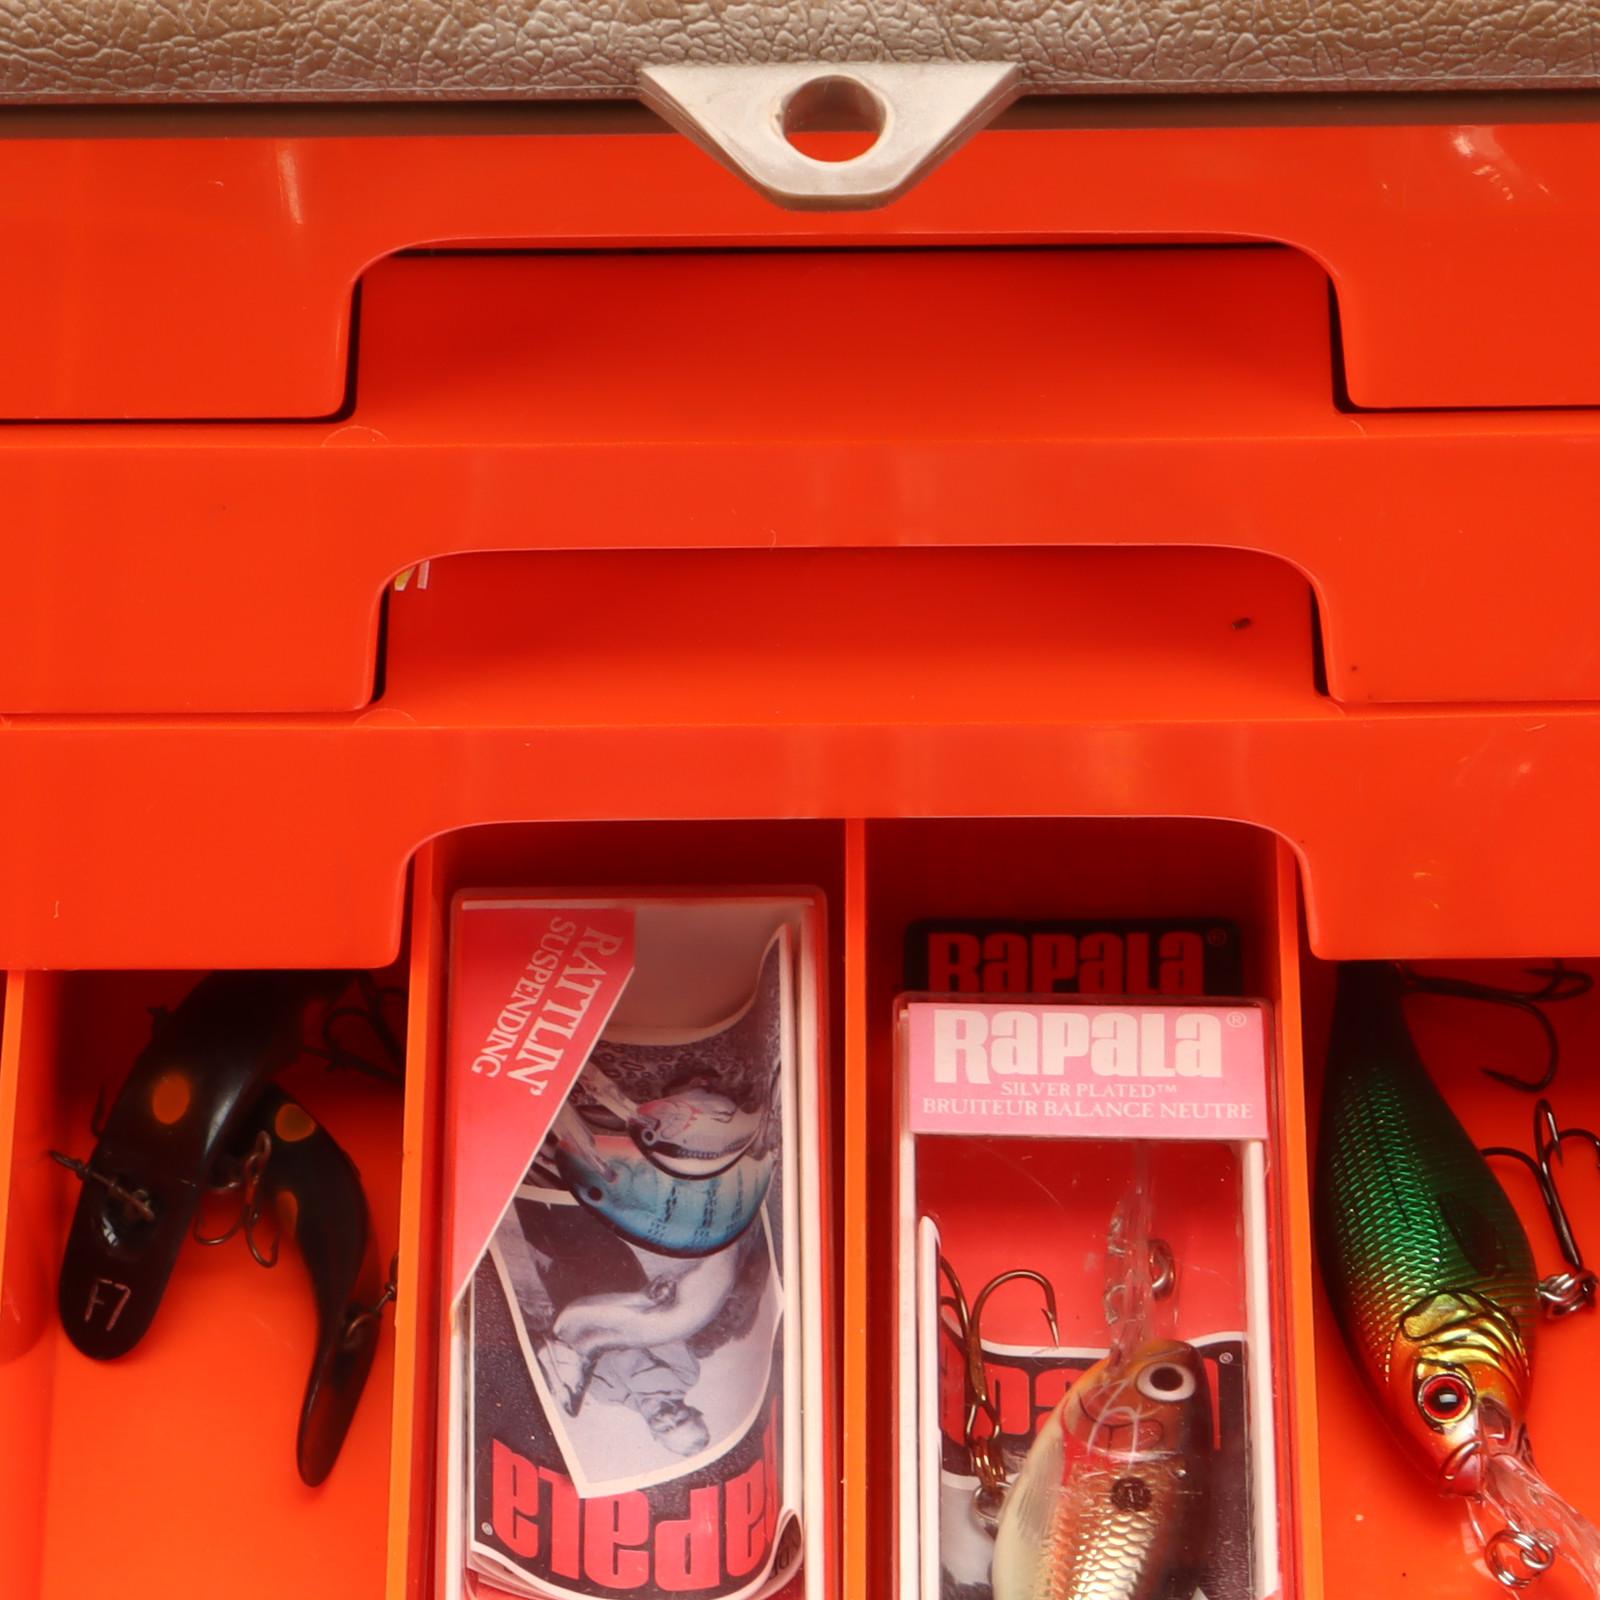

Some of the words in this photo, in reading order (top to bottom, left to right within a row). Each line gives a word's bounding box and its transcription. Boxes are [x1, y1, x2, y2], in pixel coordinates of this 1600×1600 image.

[471, 916, 577, 1078] SUSPENDING
[507, 926, 624, 1096] RATTLIN'
[922, 1097, 1039, 1117] BRUITEUR
[1043, 1100, 1155, 1120] BALANCE
[1158, 1102, 1254, 1121] NEUTRE
[1002, 1081, 1073, 1099] SILVER
